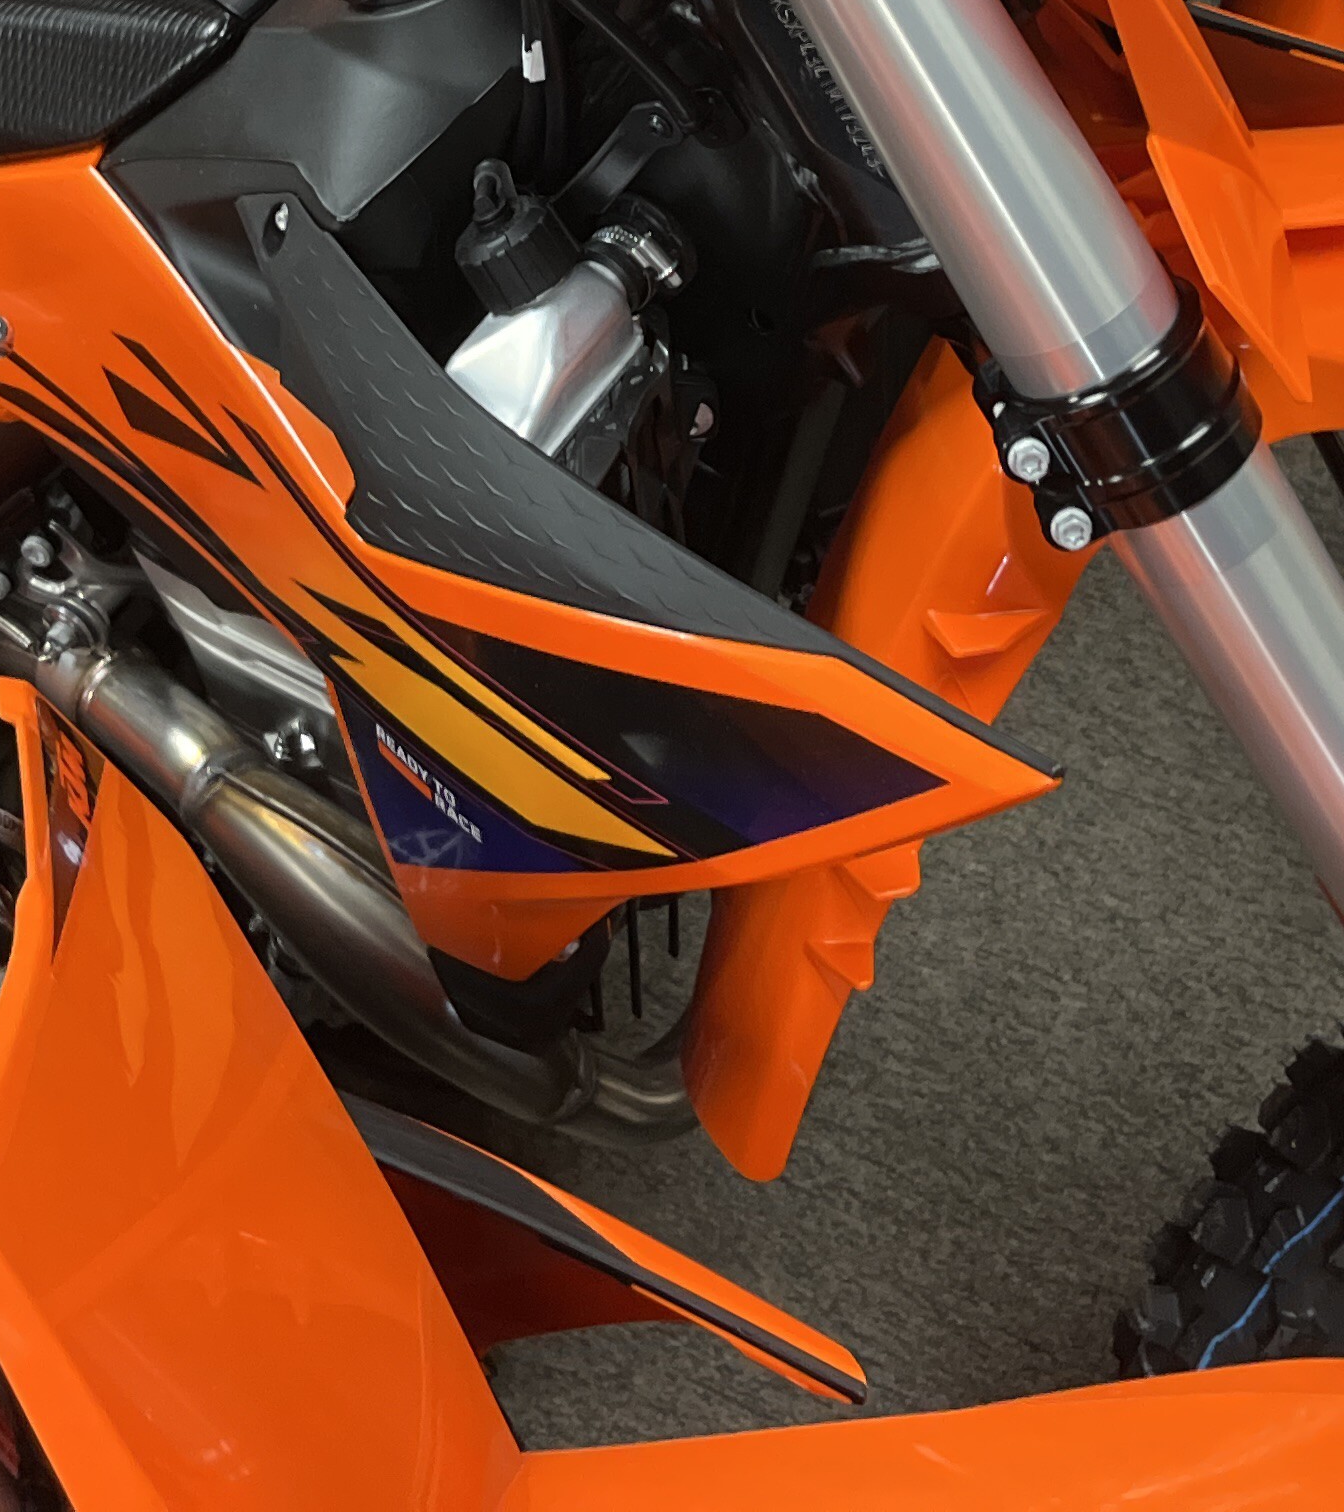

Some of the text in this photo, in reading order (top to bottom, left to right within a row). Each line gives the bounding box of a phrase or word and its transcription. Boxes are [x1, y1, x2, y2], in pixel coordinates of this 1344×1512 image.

[375, 723, 457, 808] READY TO
[433, 791, 484, 845] RACE
